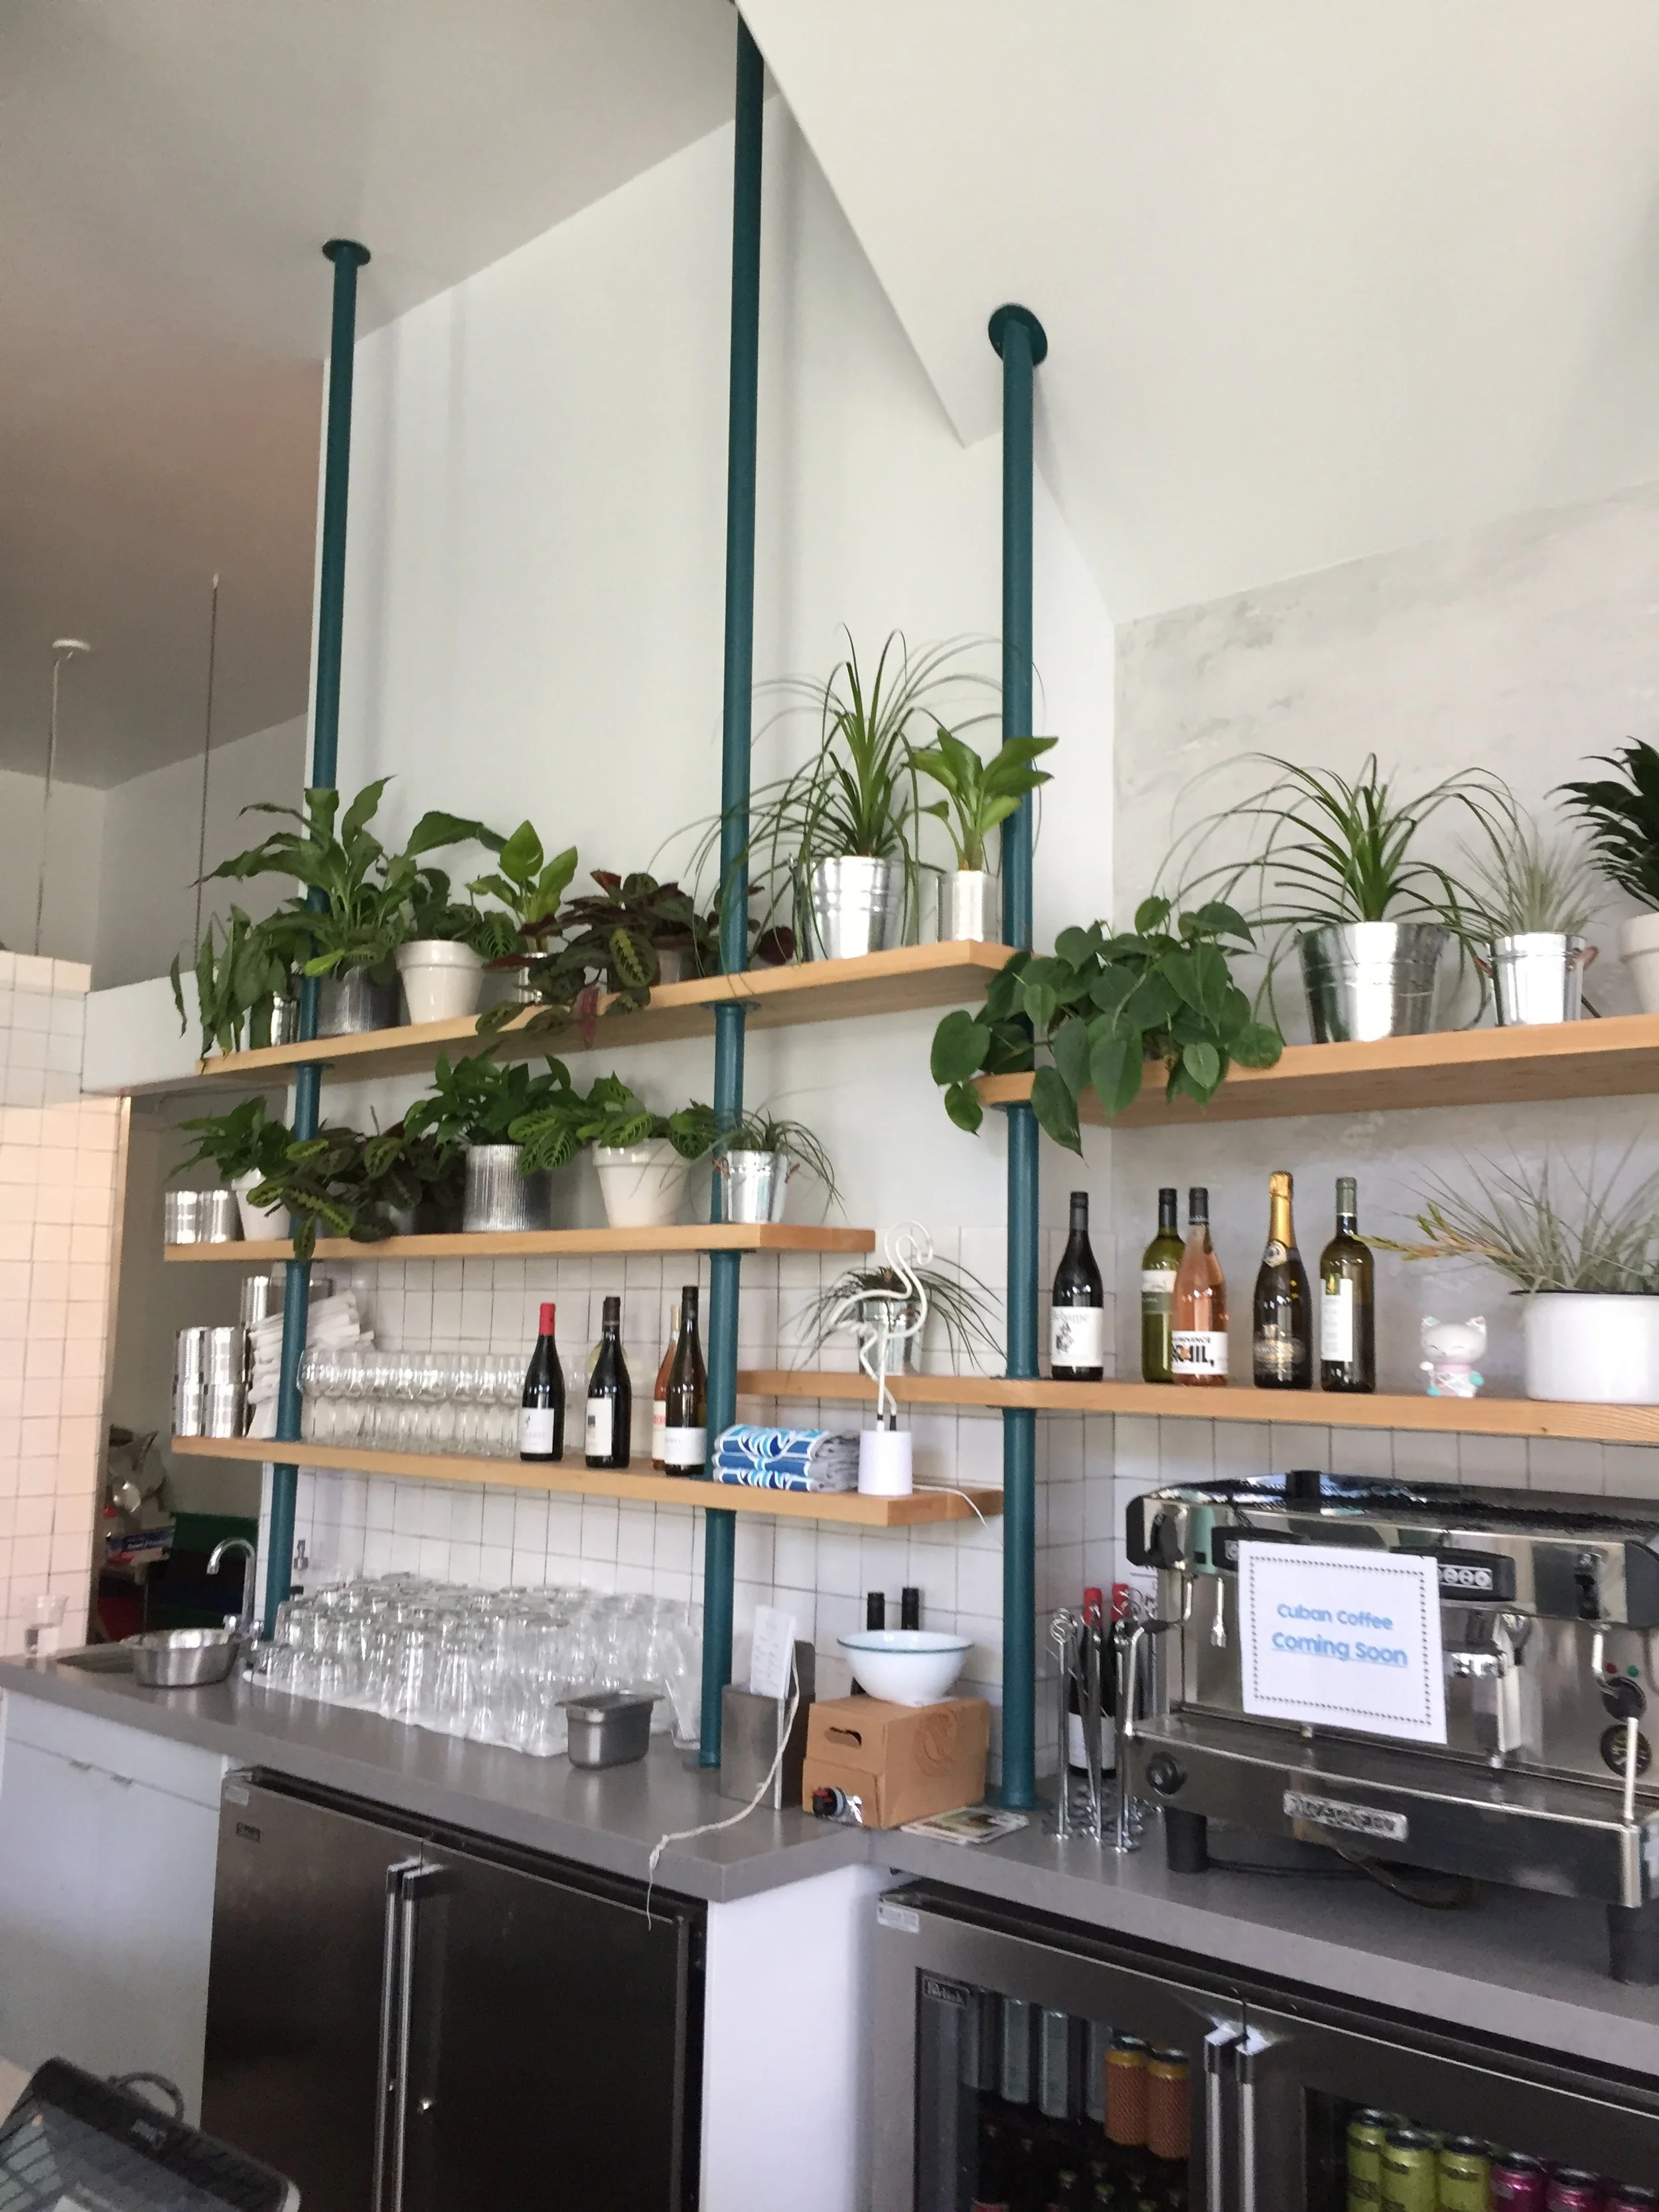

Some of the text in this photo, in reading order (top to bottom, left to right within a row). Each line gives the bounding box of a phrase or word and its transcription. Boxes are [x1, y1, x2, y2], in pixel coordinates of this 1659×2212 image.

[1277, 1603, 1394, 1631] Cuban Coffee
[1271, 1631, 1408, 1666] Coming Soon
